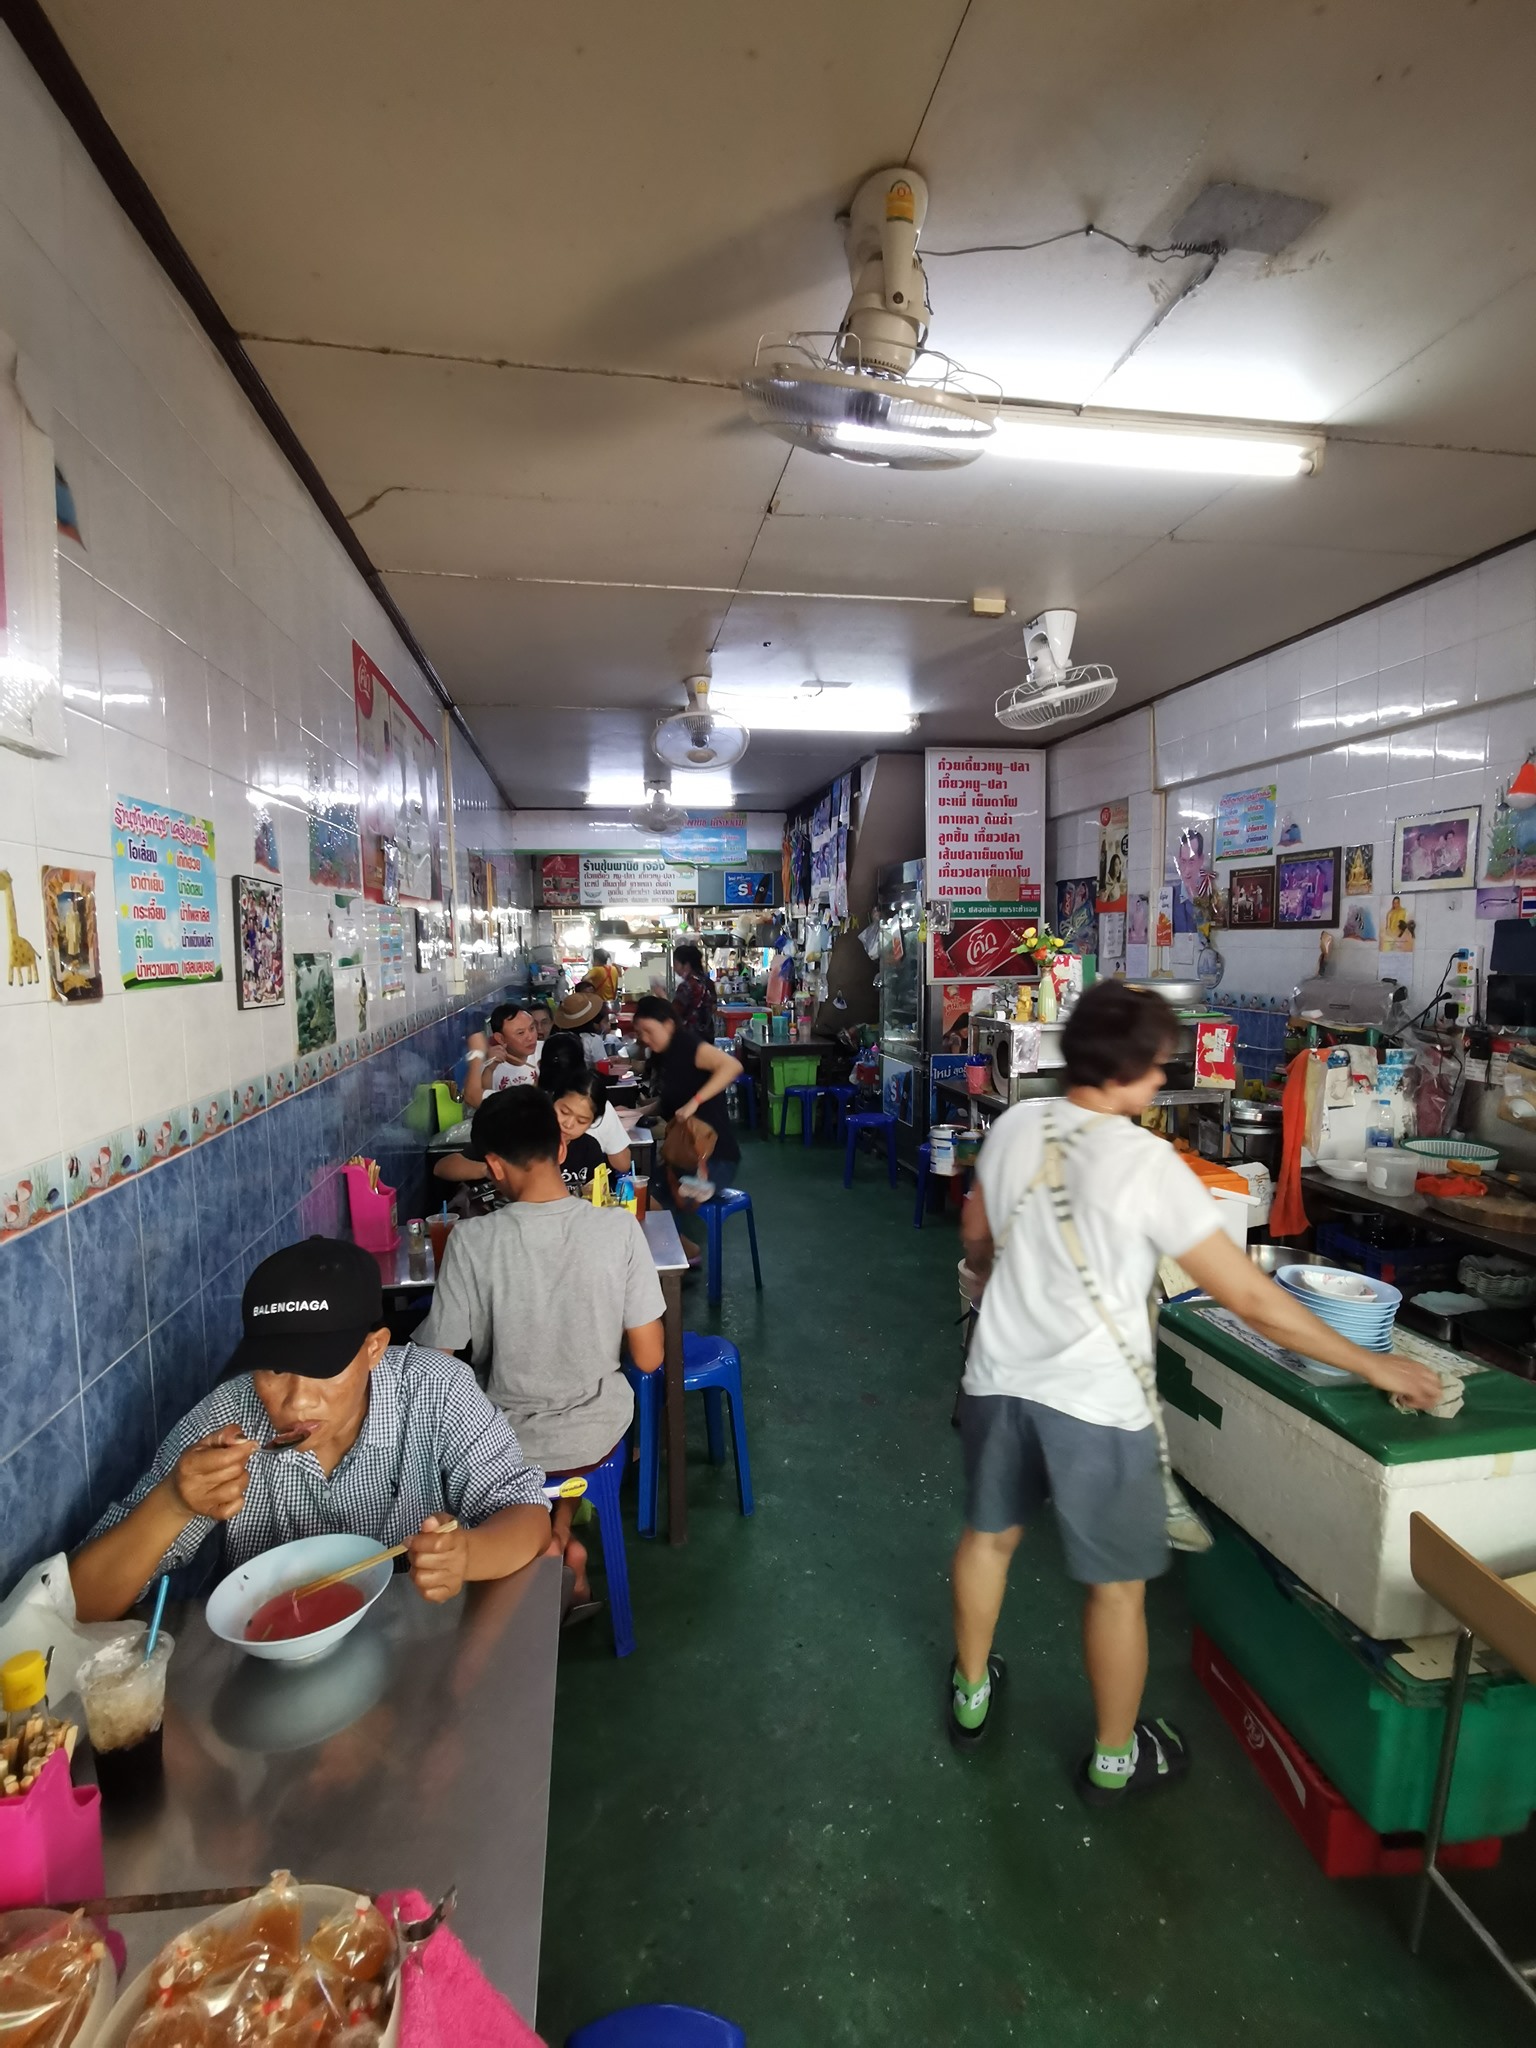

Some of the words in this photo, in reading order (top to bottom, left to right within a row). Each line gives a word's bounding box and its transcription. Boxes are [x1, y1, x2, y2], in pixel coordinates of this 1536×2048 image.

[938, 791, 966, 806] บะหมี่
[972, 793, 1017, 807] เย็นตาโฟ
[938, 814, 979, 824] เกาเหลา
[984, 811, 1012, 824] ต้มยำ
[938, 827, 968, 845] ลูกชิ้น
[974, 827, 1020, 842] เกี๊ยวปลา
[128, 839, 157, 863] โอเลี้ยง
[938, 847, 1023, 860] เส้นปลาเย็นตาโฟ
[938, 885, 982, 895] ปลาทอด
[253, 1300, 329, 1316] BALENCIAGA
